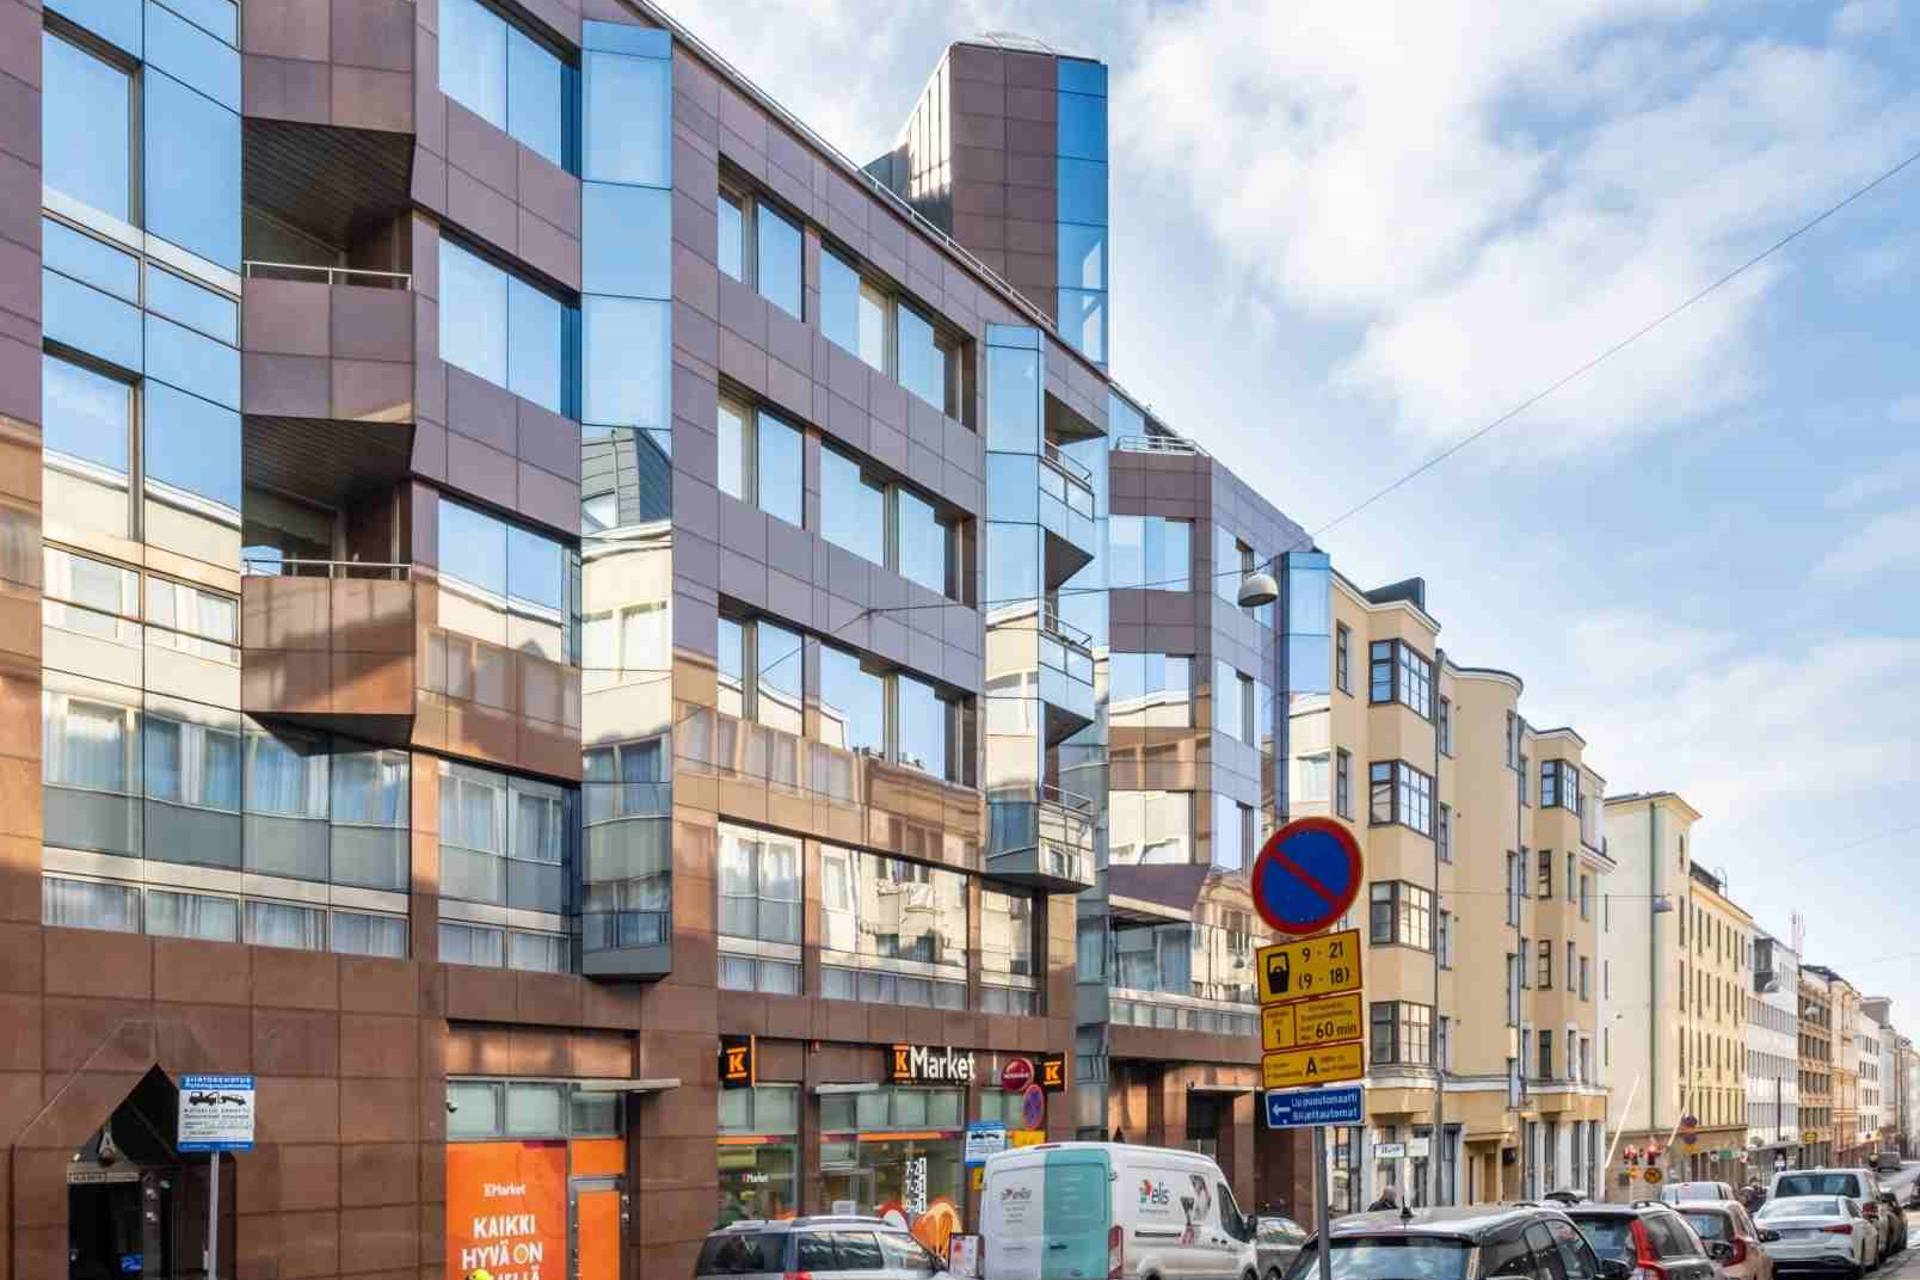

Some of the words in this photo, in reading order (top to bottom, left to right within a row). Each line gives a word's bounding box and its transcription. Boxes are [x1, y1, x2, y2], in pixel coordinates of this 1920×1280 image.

[1302, 947, 1311, 963] 9
[1328, 941, 1344, 959] 21
[1298, 973, 1312, 990] (9
[1330, 966, 1350, 986] 18)
[1275, 1028, 1282, 1045] 1
[1316, 1020, 1335, 1039] 60
[1336, 1023, 1358, 1037] min
[728, 1050, 746, 1075] K
[910, 1046, 976, 1080] Market
[1306, 1056, 1318, 1076] A
[1151, 1182, 1169, 1205] elis
[473, 1214, 536, 1238] KAIKKI
[462, 1239, 510, 1270] HYVÄ
[513, 1241, 543, 1264] ON
